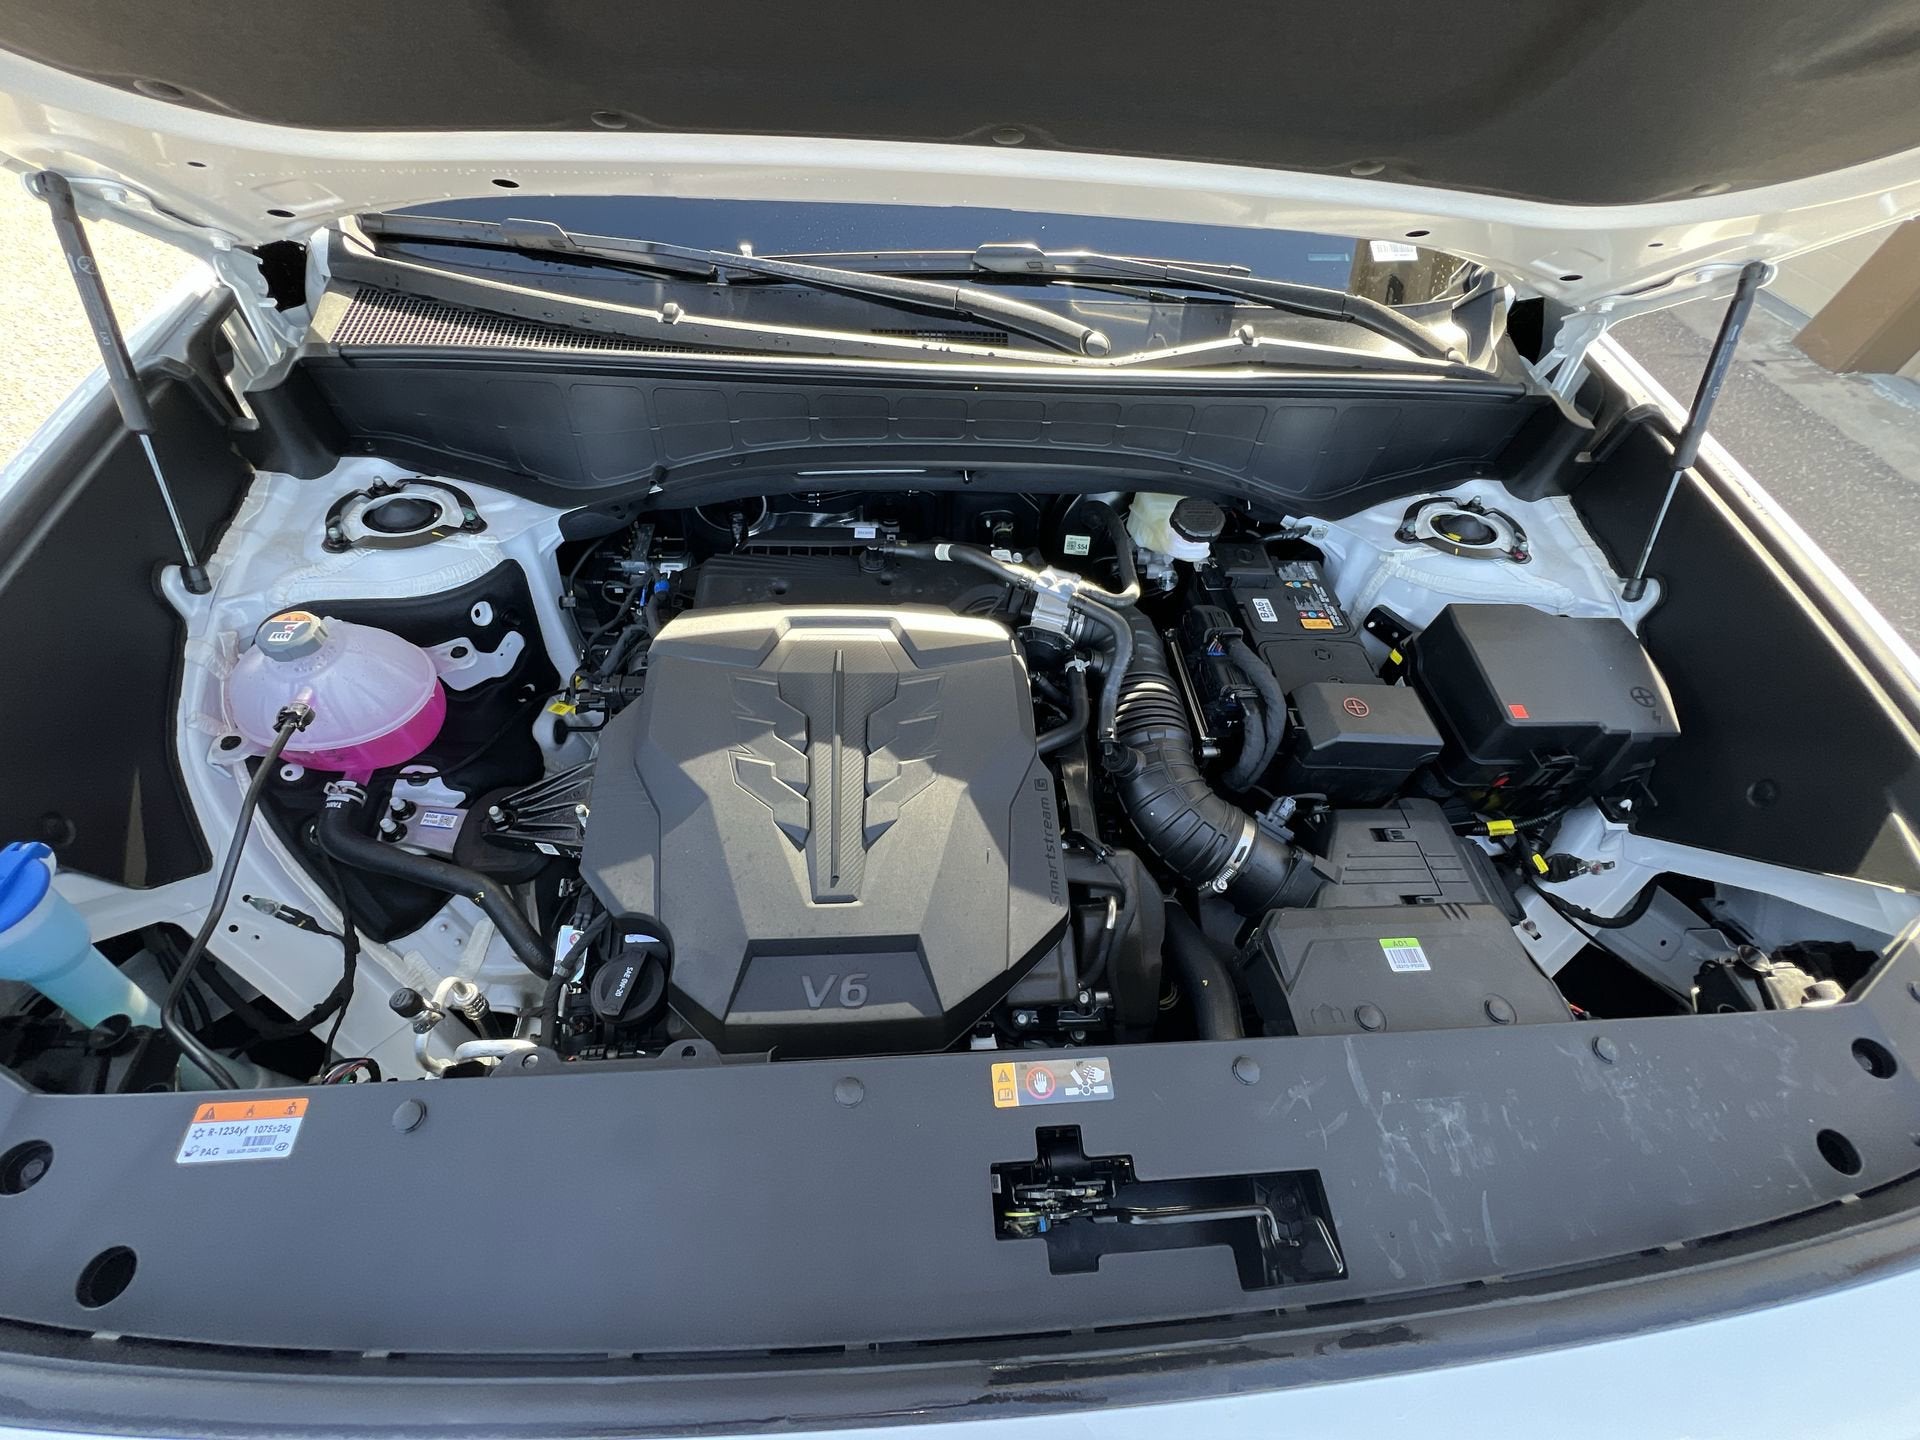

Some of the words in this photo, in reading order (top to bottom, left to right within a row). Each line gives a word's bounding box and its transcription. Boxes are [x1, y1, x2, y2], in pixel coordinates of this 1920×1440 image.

[1255, 601, 1270, 618] BA6
[1040, 797, 1061, 905] Smartstream
[623, 966, 634, 980] SAE
[801, 973, 869, 1010] V6
[207, 1125, 250, 1137] R-1234yf
[254, 1124, 292, 1135] 1075±25g
[199, 1147, 220, 1157] PAG
